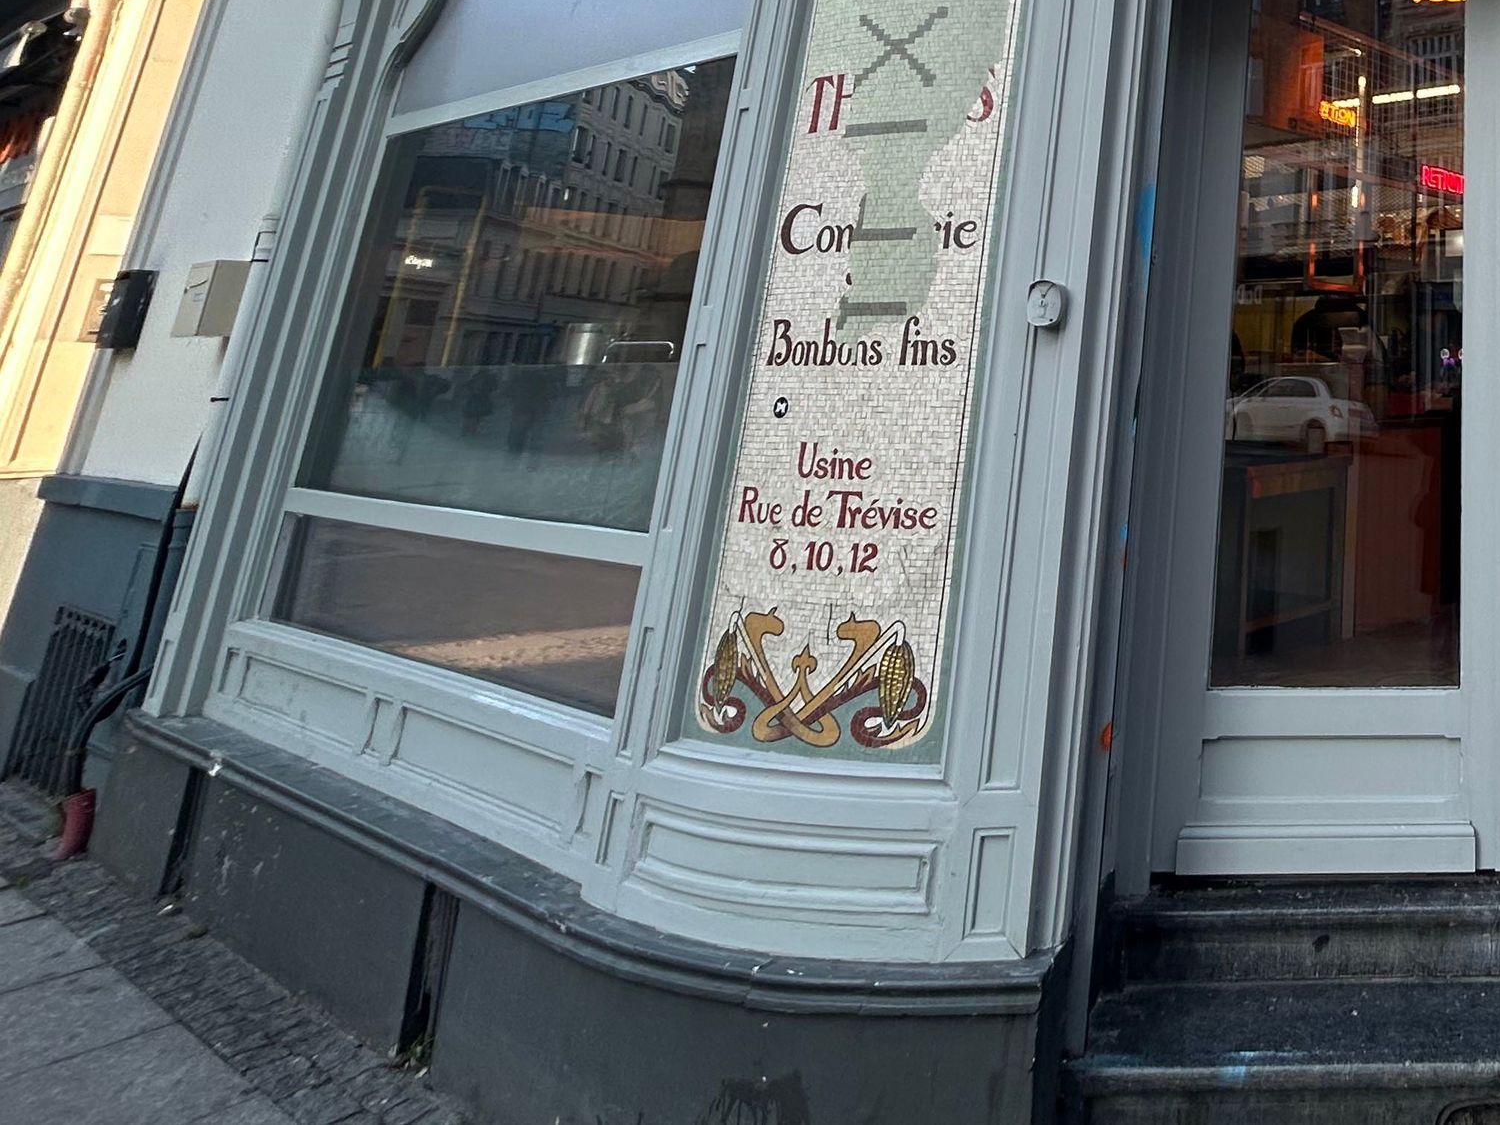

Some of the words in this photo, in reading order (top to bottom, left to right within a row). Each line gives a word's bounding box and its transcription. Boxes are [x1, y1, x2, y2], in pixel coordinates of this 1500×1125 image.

[899, 315, 958, 367] fins
[797, 441, 873, 481] Usine
[738, 486, 782, 526] Rue
[791, 491, 822, 528] de
[826, 489, 938, 531] Trévise
[849, 541, 879, 574] 12
